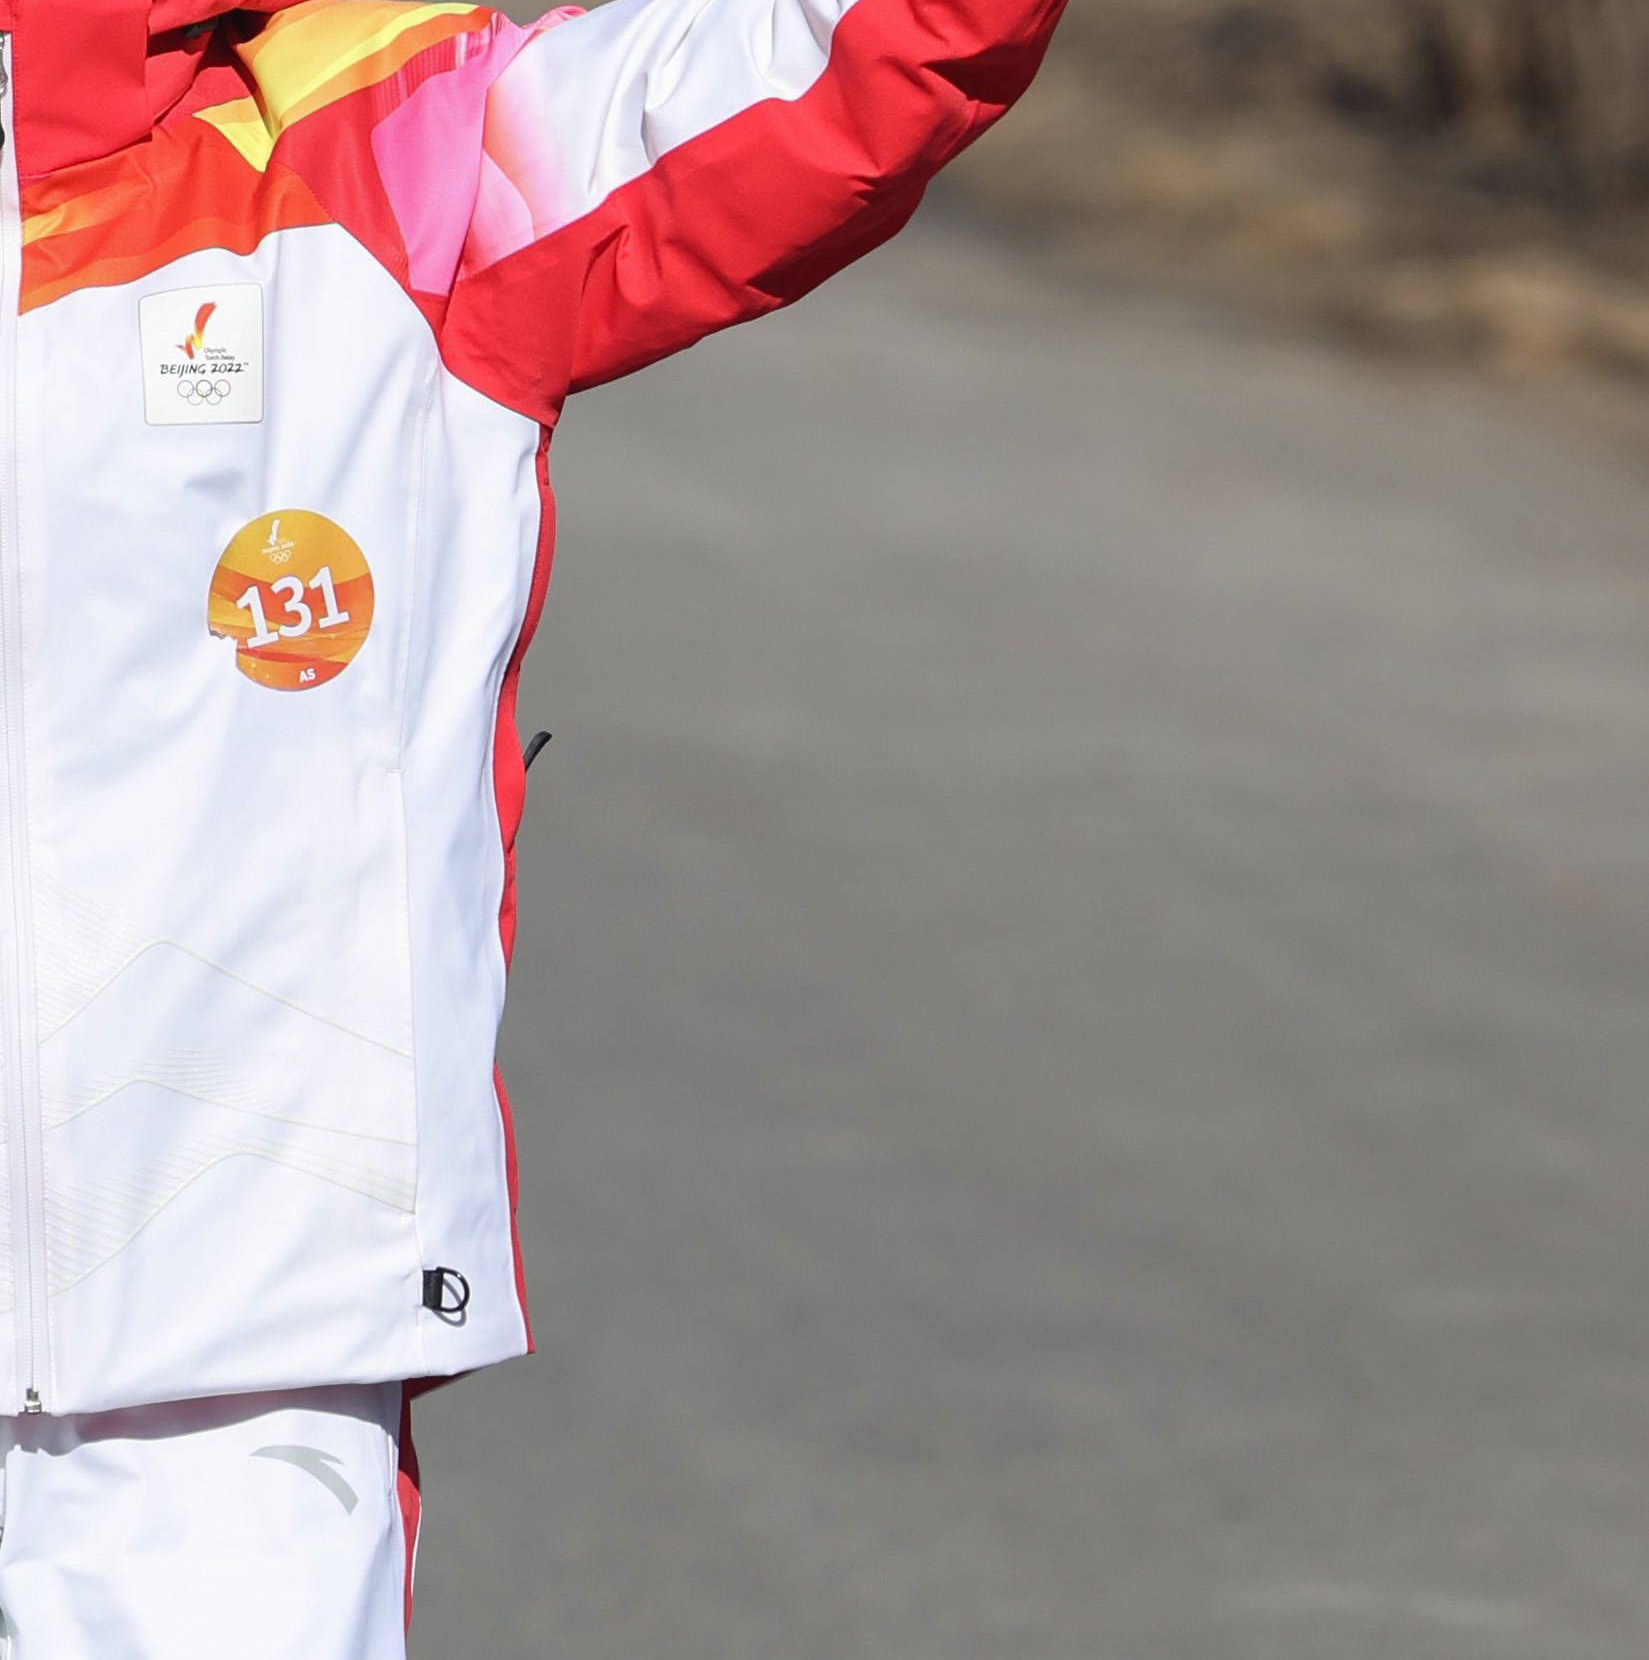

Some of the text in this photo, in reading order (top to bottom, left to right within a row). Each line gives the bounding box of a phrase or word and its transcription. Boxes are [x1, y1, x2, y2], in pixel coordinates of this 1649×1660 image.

[160, 363, 245, 378] BEIJING 2022
[236, 565, 350, 648] 131
[299, 667, 317, 683] AS
